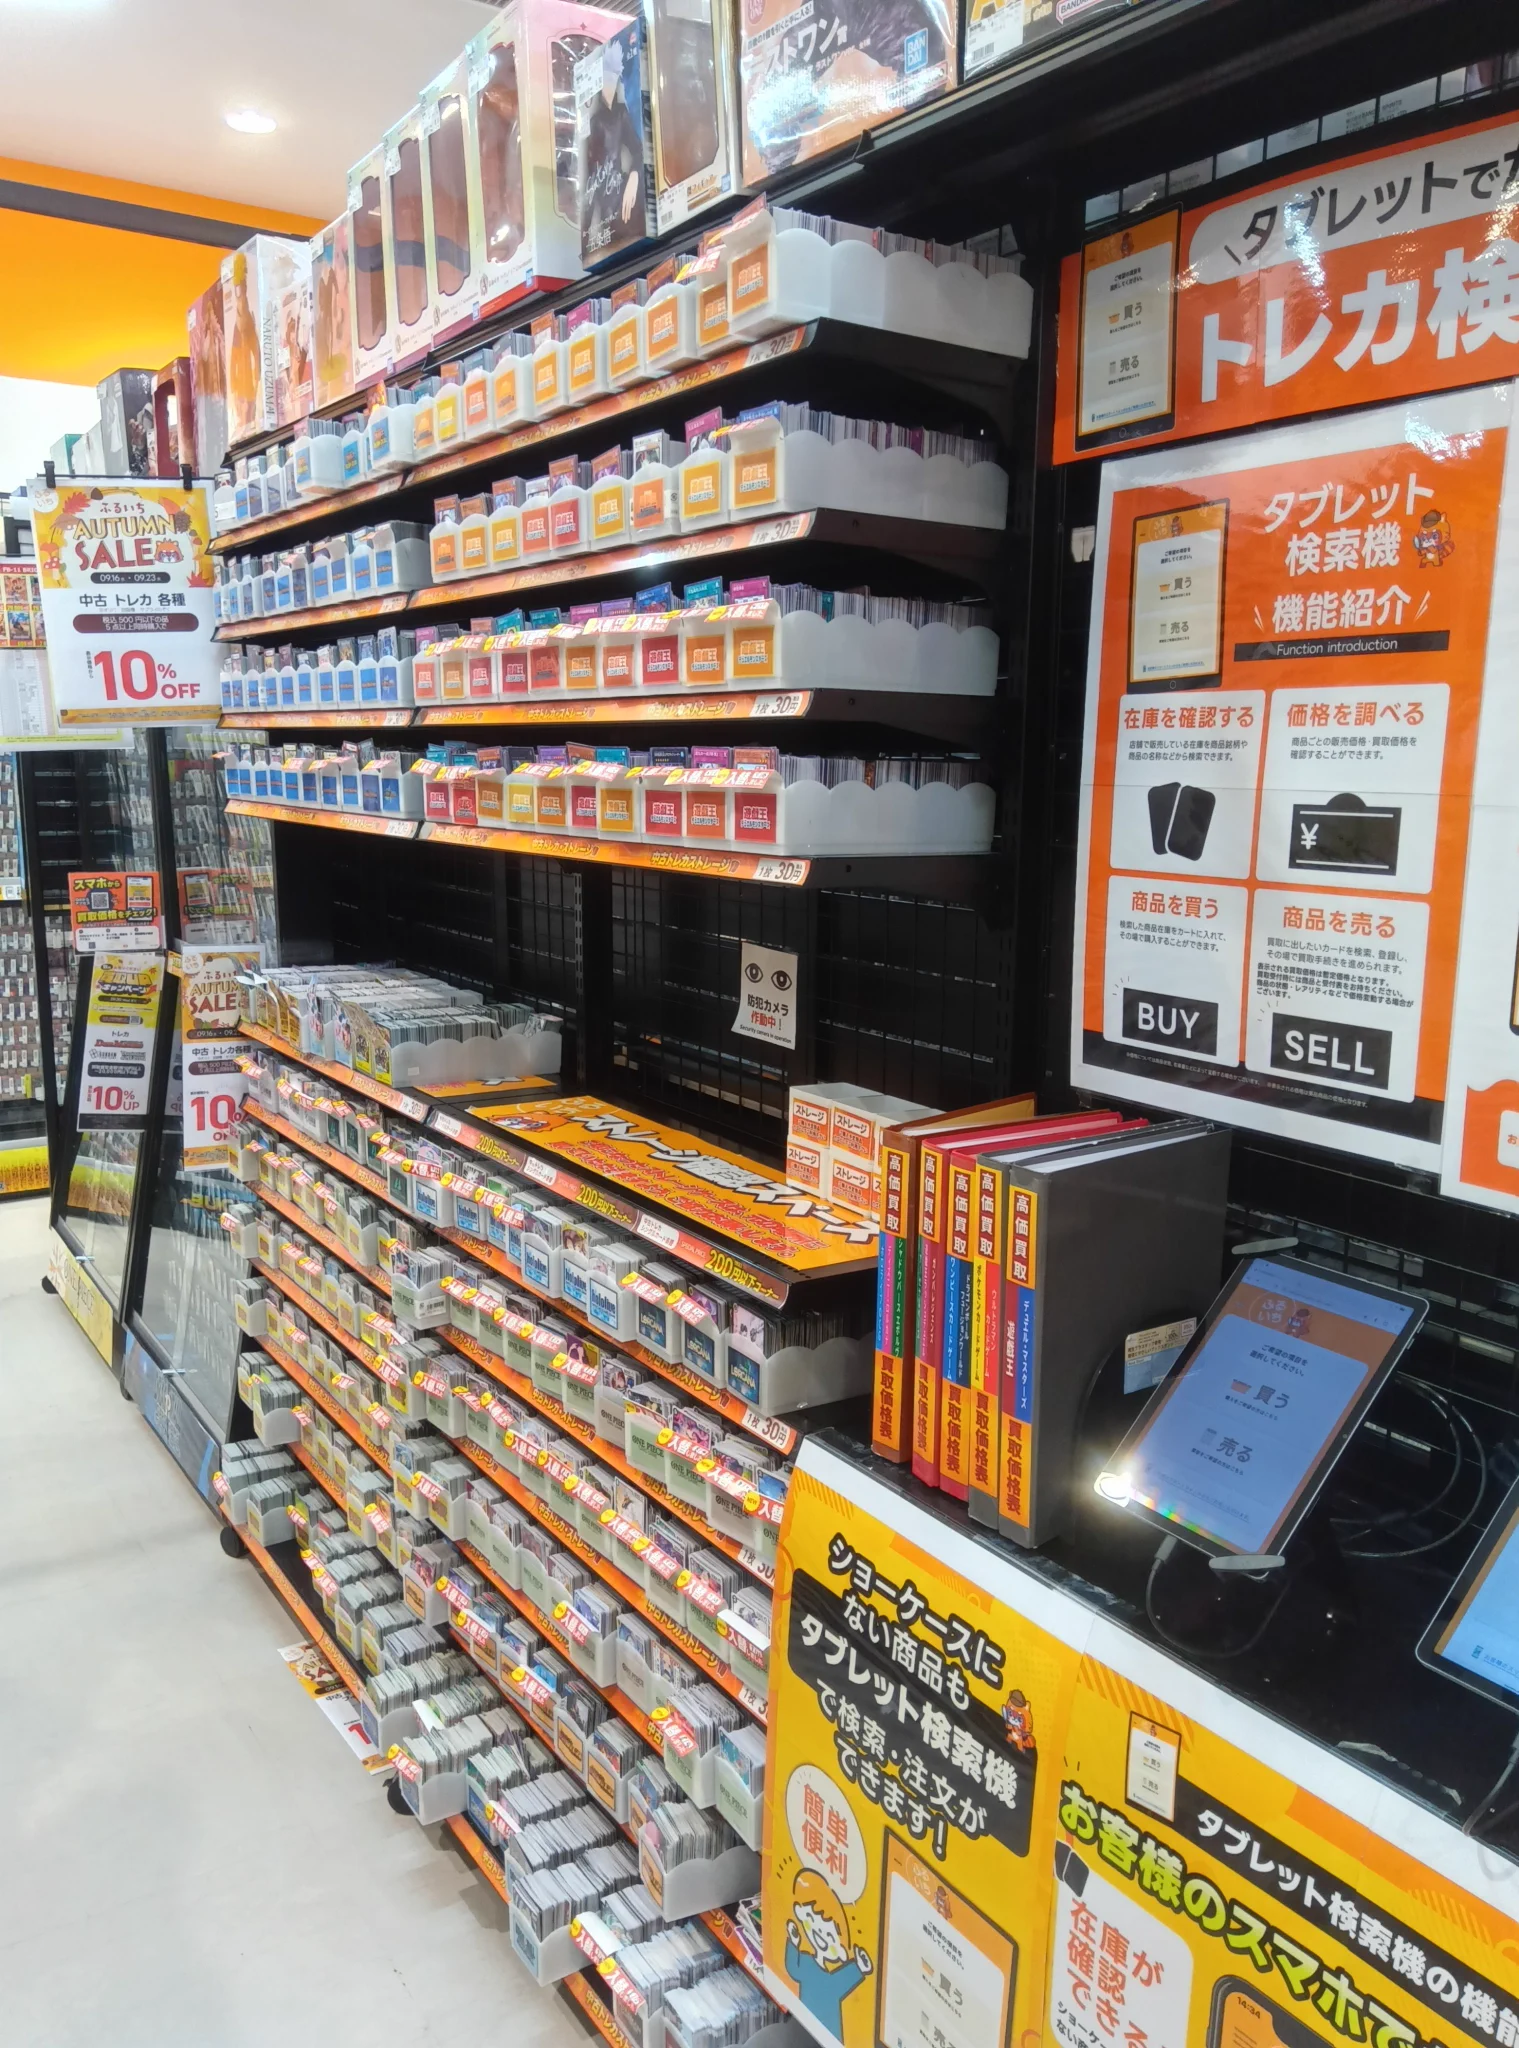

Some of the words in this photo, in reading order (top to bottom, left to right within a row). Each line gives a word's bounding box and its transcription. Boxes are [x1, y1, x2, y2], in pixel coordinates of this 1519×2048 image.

[907, 36, 926, 52] BAN
[907, 51, 923, 68] DAI
[586, 226, 616, 253] 五条悟
[1123, 302, 1142, 321] 買う
[263, 317, 275, 365] NARUTO
[1120, 355, 1139, 373] 売る
[100, 501, 146, 514] ふるいち
[1264, 472, 1435, 533] タブレット
[72, 513, 176, 541] AUTUMN
[771, 521, 799, 543] 30円
[74, 538, 156, 572] SALE
[1284, 521, 1402, 577] 検索機
[1174, 577, 1193, 591] 買う
[79, 593, 108, 608] 中古
[115, 593, 152, 607] トレカ
[158, 592, 186, 607] 各種
[1271, 584, 1412, 634] 機能紹介
[118, 616, 133, 624] 500
[1170, 621, 1190, 636] 売る
[649, 650, 672, 663] 遊戯王
[693, 649, 717, 662] 遊戯王
[741, 641, 766, 655] 遊戯王
[1276, 642, 1324, 657] Function
[1327, 638, 1399, 654] introduction
[94, 649, 158, 701] 10
[157, 663, 178, 679] %
[161, 683, 201, 700] OFF
[649, 701, 727, 718] 中古トレカストレージ
[755, 703, 770, 714] 1枚
[772, 695, 798, 714] 30円
[1123, 706, 1255, 730] 在庫を確認する
[1286, 701, 1425, 728] 価格を調べる
[1129, 740, 1249, 750] 店舗で販売している在庫を商品銘柄や
[1290, 749, 1384, 760] 確認することができます。
[1291, 736, 1418, 747] 商品ごとの販売価格・買取価格を
[1128, 751, 1234, 762] 商品の名称などから検索できます。
[743, 806, 768, 820] 遊戯王
[650, 851, 731, 873] 中古トレカストレージ
[758, 866, 771, 878] 1枚
[774, 860, 802, 881] 30円
[74, 877, 121, 891] スマホから
[1131, 890, 1219, 919] 商品を買う
[1119, 920, 1227, 942] 検索した商品在庫をカートに入れて、
[1283, 905, 1397, 940] 商品を売る
[1119, 931, 1219, 953] その場で購入することができます。
[1266, 936, 1409, 964] 買取に出したいカードを検索、登録し、
[1257, 962, 1390, 987] 表示される買取価格は暫定価格となります。
[1266, 949, 1403, 976] その場で買取手続きを進められます。
[189, 993, 237, 1015] SALE
[747, 993, 789, 1017] 防犯カメラ
[1256, 979, 1414, 1008] 商品の状態・レアリティなどで価格変動する場合が
[1256, 988, 1292, 999] ございます。
[111, 1030, 130, 1038] トレカ
[739, 1023, 756, 1034] Security
[774, 1033, 792, 1045] operation
[1138, 1001, 1201, 1040] BUY
[192, 1047, 209, 1057] 中古
[1283, 1029, 1377, 1077] SELL
[92, 1085, 123, 1111] 10
[123, 1090, 136, 1101] %
[123, 1101, 140, 1111] UP
[190, 1093, 236, 1131] 10
[795, 1104, 825, 1121] ストレージ
[836, 1114, 867, 1134] ストレージ
[478, 1134, 520, 1167] 200円以下コーナー
[1507, 1133, 1518, 1145] お
[788, 1148, 817, 1165] ストレージ
[835, 1166, 867, 1185] ストレージ
[578, 1183, 633, 1225] 200円以下コーナー
[885, 1153, 902, 1232] 高価買取
[922, 1154, 936, 1236] 高価買取
[457, 1203, 478, 1222] hololive
[640, 1217, 663, 1230] 中古トレカ
[953, 1172, 969, 1256] 高価買取
[979, 1171, 995, 1257] 高価買取
[680, 1242, 696, 1254] SPECIAL
[694, 1248, 707, 1260] PRICE
[1012, 1193, 1031, 1282] 高価買取
[526, 1248, 548, 1275] hololive
[704, 1249, 780, 1300] 200円以下コーナー
[564, 1264, 587, 1290] hololive
[591, 1287, 616, 1315] hololive
[963, 1274, 972, 1341] ドラゴンボール
[946, 1256, 956, 1380] ワンピースカードゲーム
[974, 1264, 983, 1381] ポケモンカードゲーム
[990, 1288, 998, 1351] ウルトラマン
[957, 1290, 967, 1378] フュージョンワールド
[983, 1314, 992, 1378] カードゲーム
[1020, 1300, 1031, 1410] デュエル・マスターズ
[1249, 1350, 1305, 1378] 選択してください。
[1261, 1343, 1309, 1367] ご希望の項目を
[567, 1381, 580, 1393] ONE
[646, 1349, 722, 1401] 中古トレカストレージ
[746, 1412, 759, 1429] 1枚
[761, 1416, 787, 1446] 30円
[879, 1354, 895, 1441] 買取価格表
[1253, 1384, 1291, 1411] 買う
[532, 1388, 591, 1438] 中古トレカ・ストレージ
[601, 1409, 614, 1421] ONE
[917, 1362, 929, 1453] 買取価格表
[946, 1383, 962, 1475] 買取価格表
[974, 1391, 989, 1486] 買取価格表
[631, 1433, 646, 1448] ONE
[645, 1439, 664, 1458] PIECE
[1216, 1436, 1253, 1464] 売る
[671, 1459, 685, 1474] ONE
[684, 1465, 706, 1485] PIECE
[1006, 1417, 1022, 1517] 買取価格表
[715, 1494, 729, 1511] ONE
[747, 1497, 758, 1505] NEW
[537, 1503, 596, 1558] 中古トレカ・ストレージ
[741, 1549, 754, 1565] 1枚
[831, 1538, 1002, 1683] ショーケースに
[645, 1602, 718, 1668] 中古トレカストレージ
[843, 1595, 970, 1711] ない商品も
[800, 1612, 1018, 1810] タブレット検索機
[816, 1677, 988, 1833] で検索・注文が
[731, 1793, 748, 1819] PIECE
[838, 1737, 946, 1856] できます!
[803, 1783, 849, 1849] 簡単
[801, 1818, 848, 1886] 便利
[1070, 1897, 1165, 1988] 在庫が
[1067, 1928, 1127, 2006] 確認
[939, 1972, 963, 2007] 買う
[1236, 1996, 1262, 2020] 14:34
